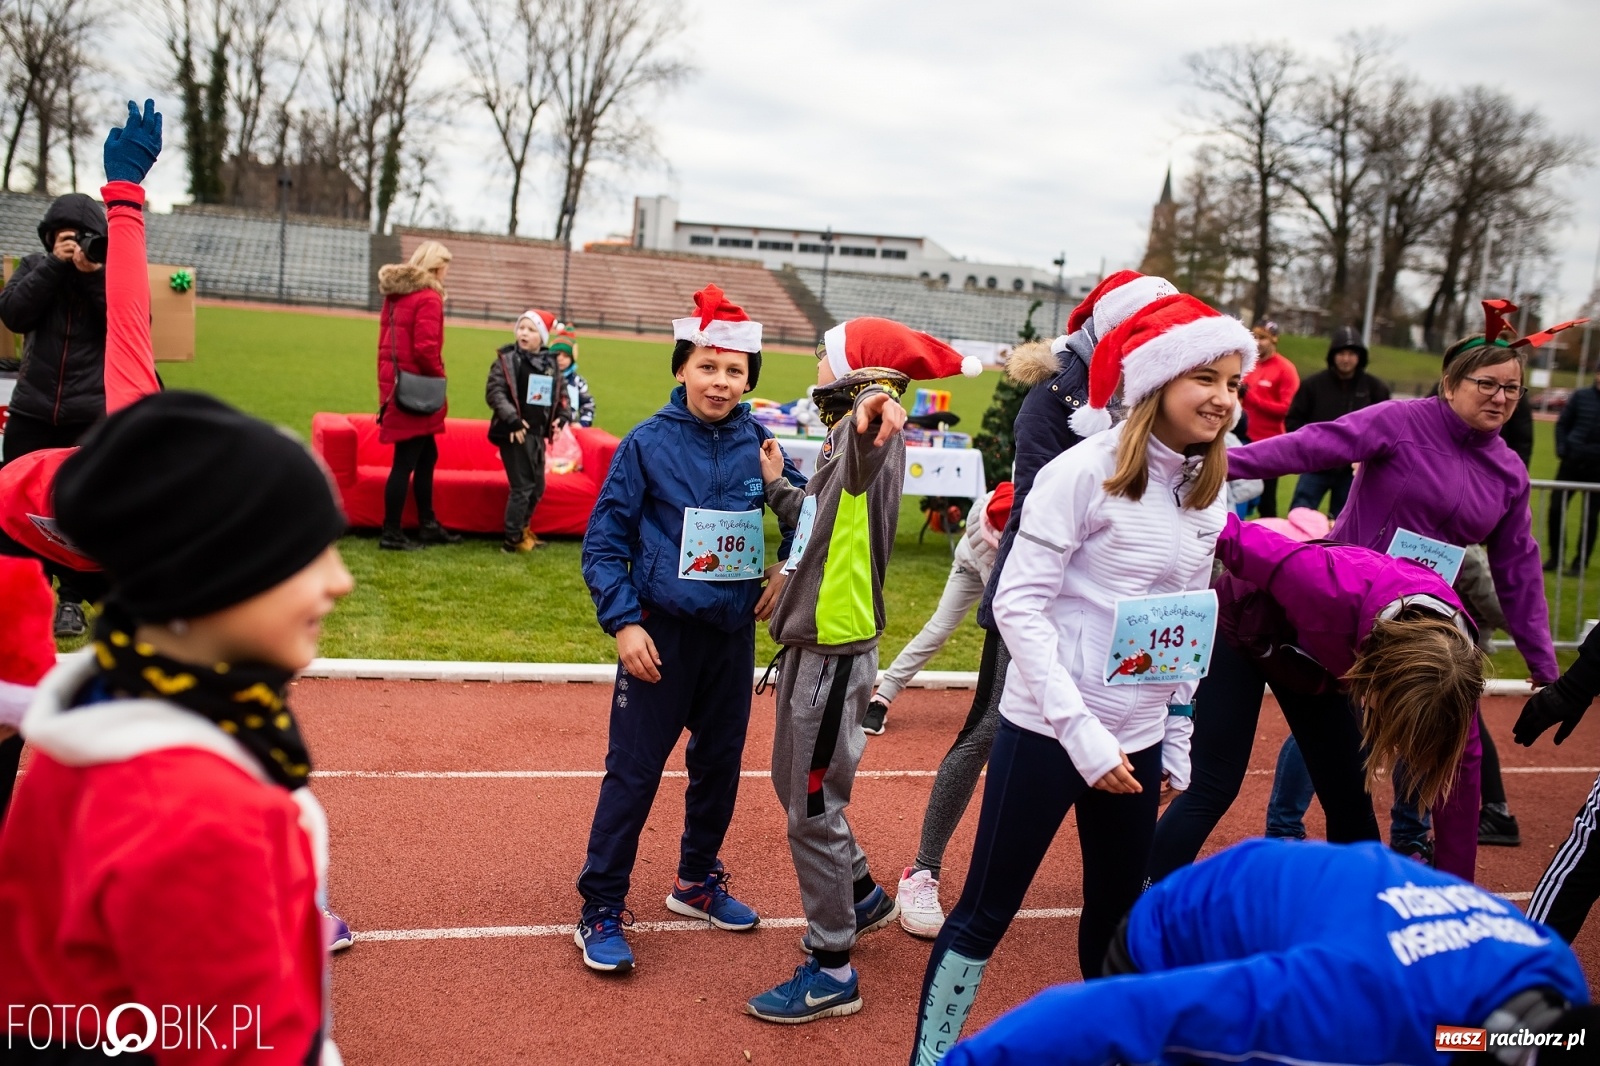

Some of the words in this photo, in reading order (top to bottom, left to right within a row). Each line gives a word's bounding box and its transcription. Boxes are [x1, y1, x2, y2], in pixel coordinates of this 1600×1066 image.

[694, 521, 716, 531] Bieg
[716, 535, 746, 552] 186
[1126, 614, 1149, 626] Bieg
[1149, 625, 1184, 650] 143
